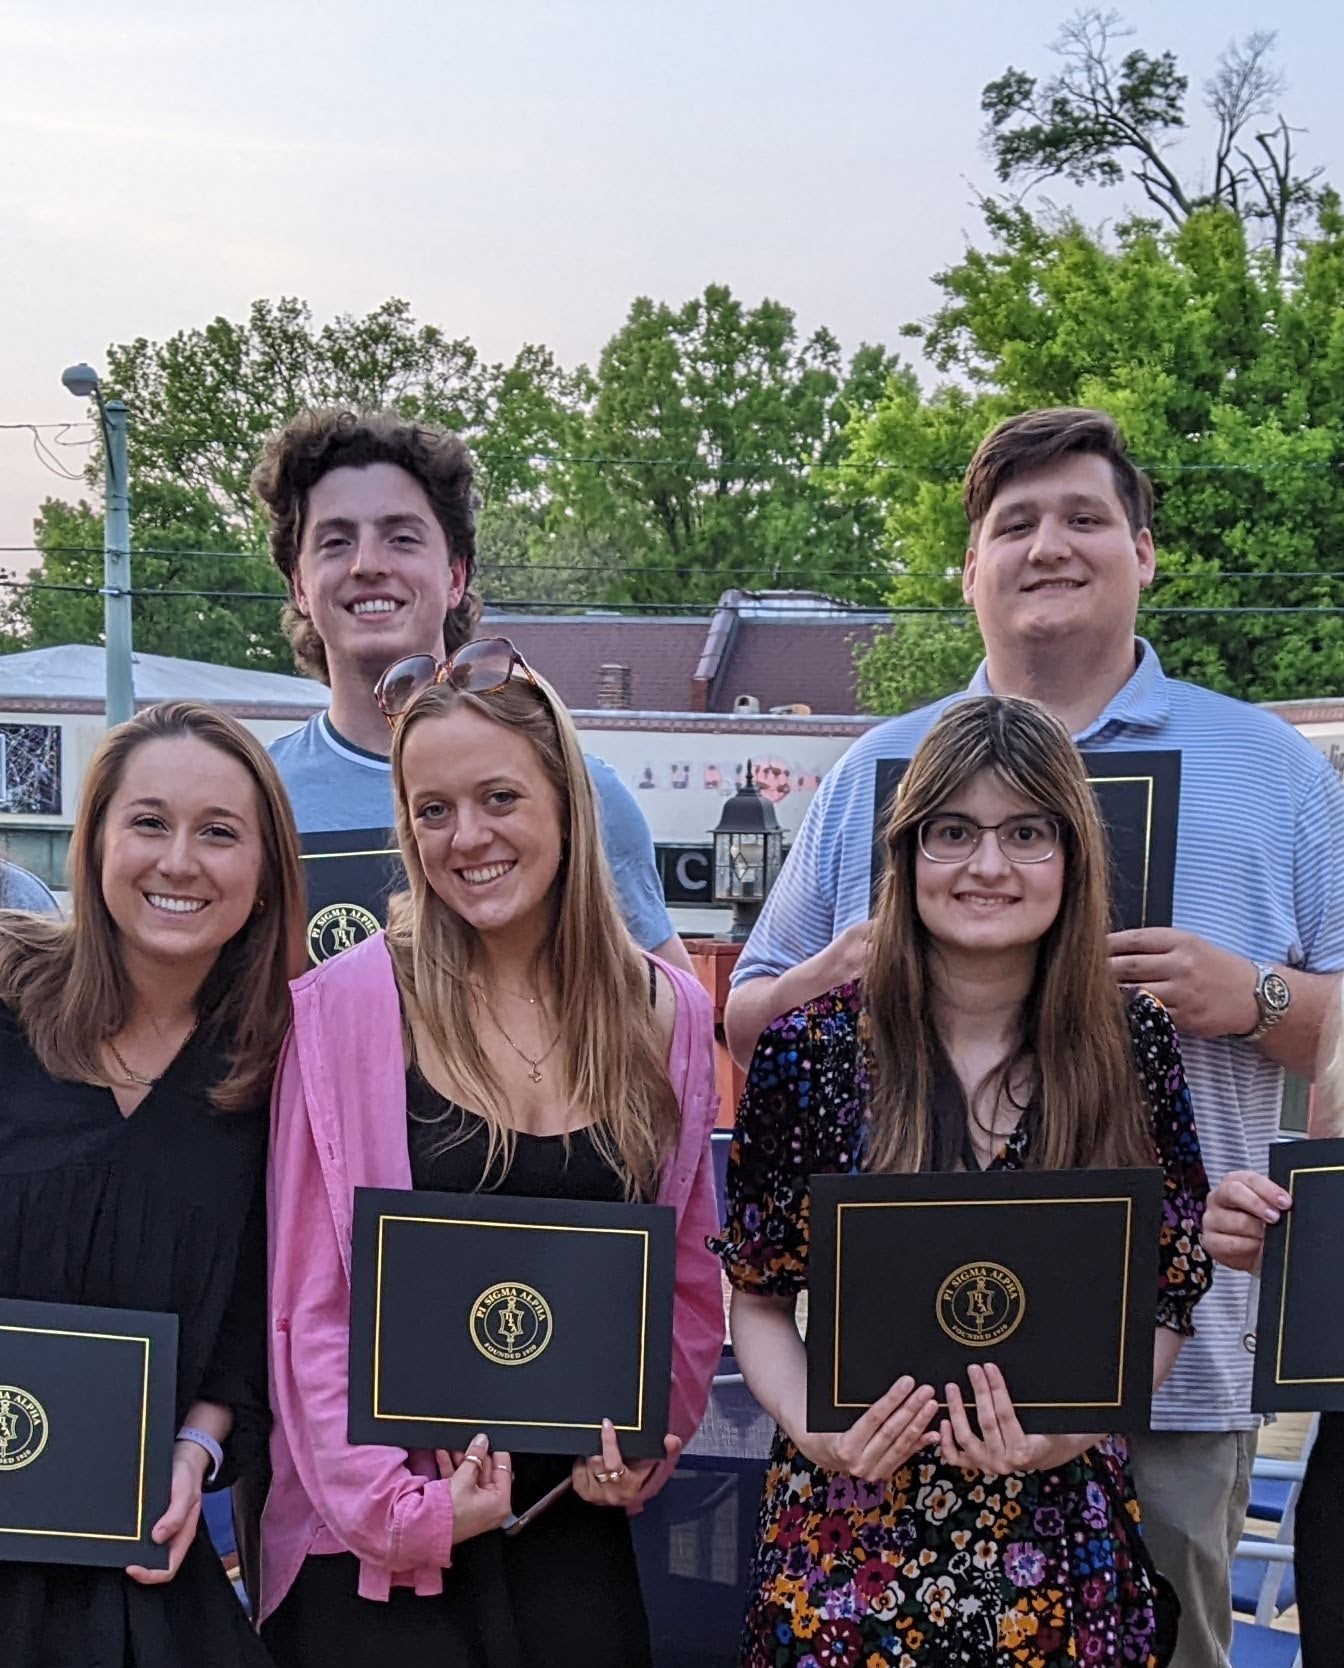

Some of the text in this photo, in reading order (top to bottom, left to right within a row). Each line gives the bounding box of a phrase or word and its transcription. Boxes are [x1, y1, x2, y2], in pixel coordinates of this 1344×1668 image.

[312, 909, 376, 938] PI SIGMA ALPHA
[943, 1268, 1018, 1300] PI SIGMA ALPHA
[476, 1288, 546, 1321] PI SIGMA ALPHA
[952, 1325, 992, 1340] FOUNDED
[484, 1343, 537, 1359] FOUNDED 1920
[14, 1395, 41, 1426] ALPHA
